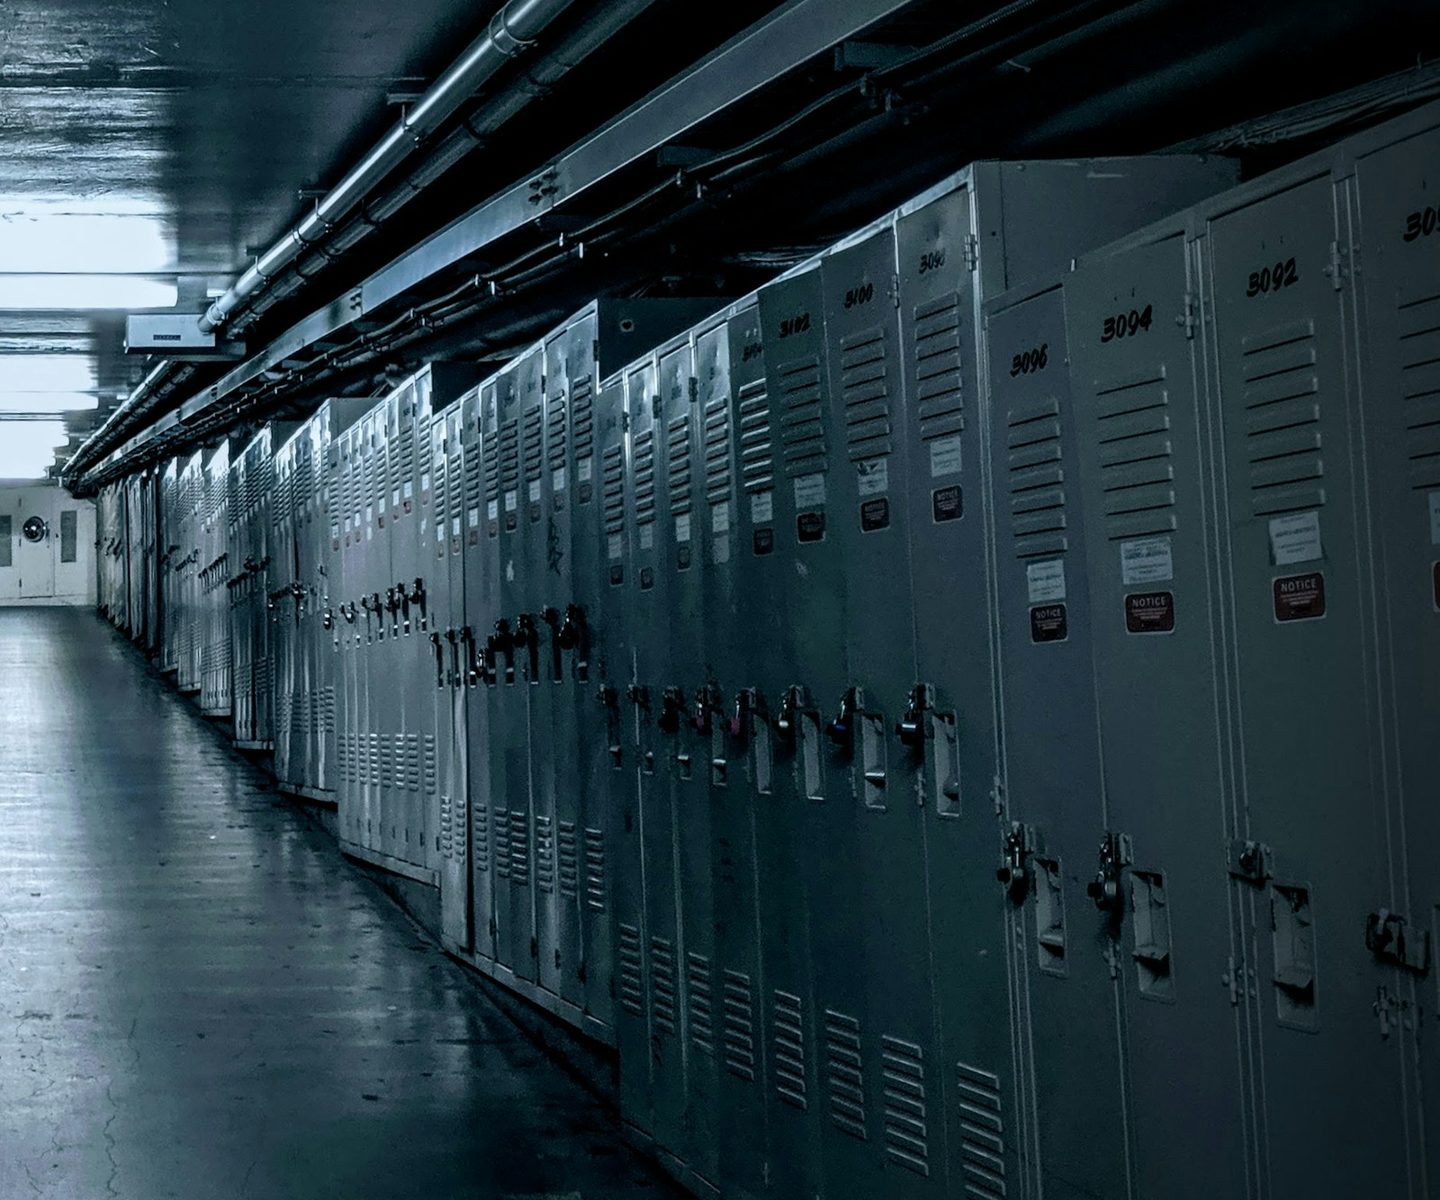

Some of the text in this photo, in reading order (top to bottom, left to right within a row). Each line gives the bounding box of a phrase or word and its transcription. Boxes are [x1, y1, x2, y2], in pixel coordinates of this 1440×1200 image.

[1403, 206, 1440, 242] 30
[1247, 257, 1298, 297] 3092
[1101, 304, 1152, 343] 3094
[1010, 343, 1048, 377] 3096
[1132, 596, 1166, 608] NOTICE
[1280, 578, 1317, 593] NOTICE
[1035, 608, 1061, 619] NOTICE
